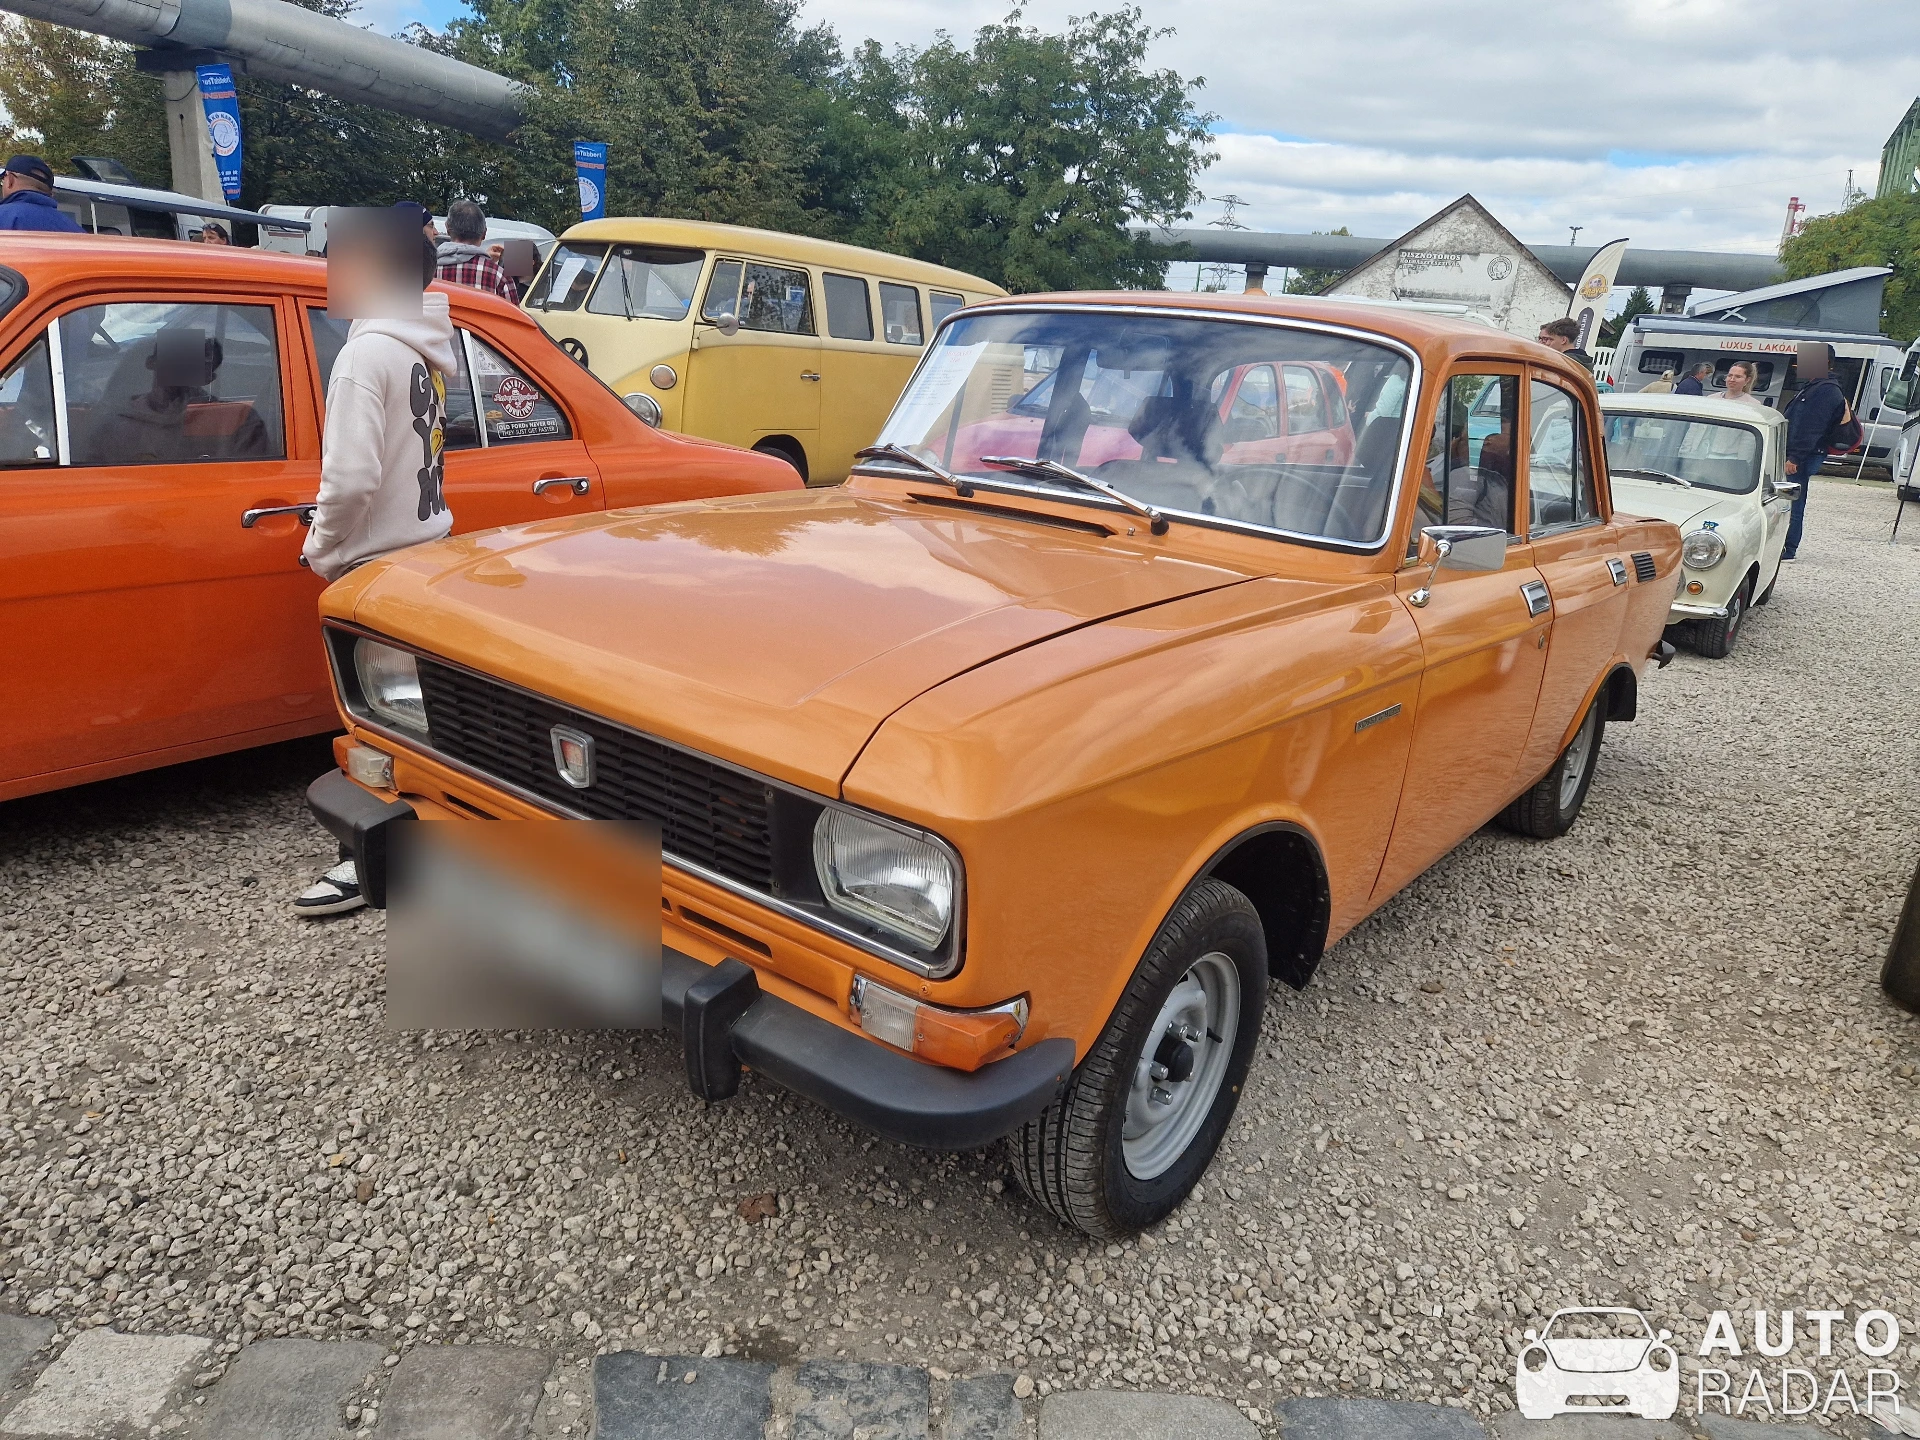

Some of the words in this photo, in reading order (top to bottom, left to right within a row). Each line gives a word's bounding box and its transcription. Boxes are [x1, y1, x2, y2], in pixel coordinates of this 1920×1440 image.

[1720, 341, 1753, 350] LUXUS
[1758, 342, 1797, 352] LAKÓAU
[538, 425, 556, 433] FASTER
